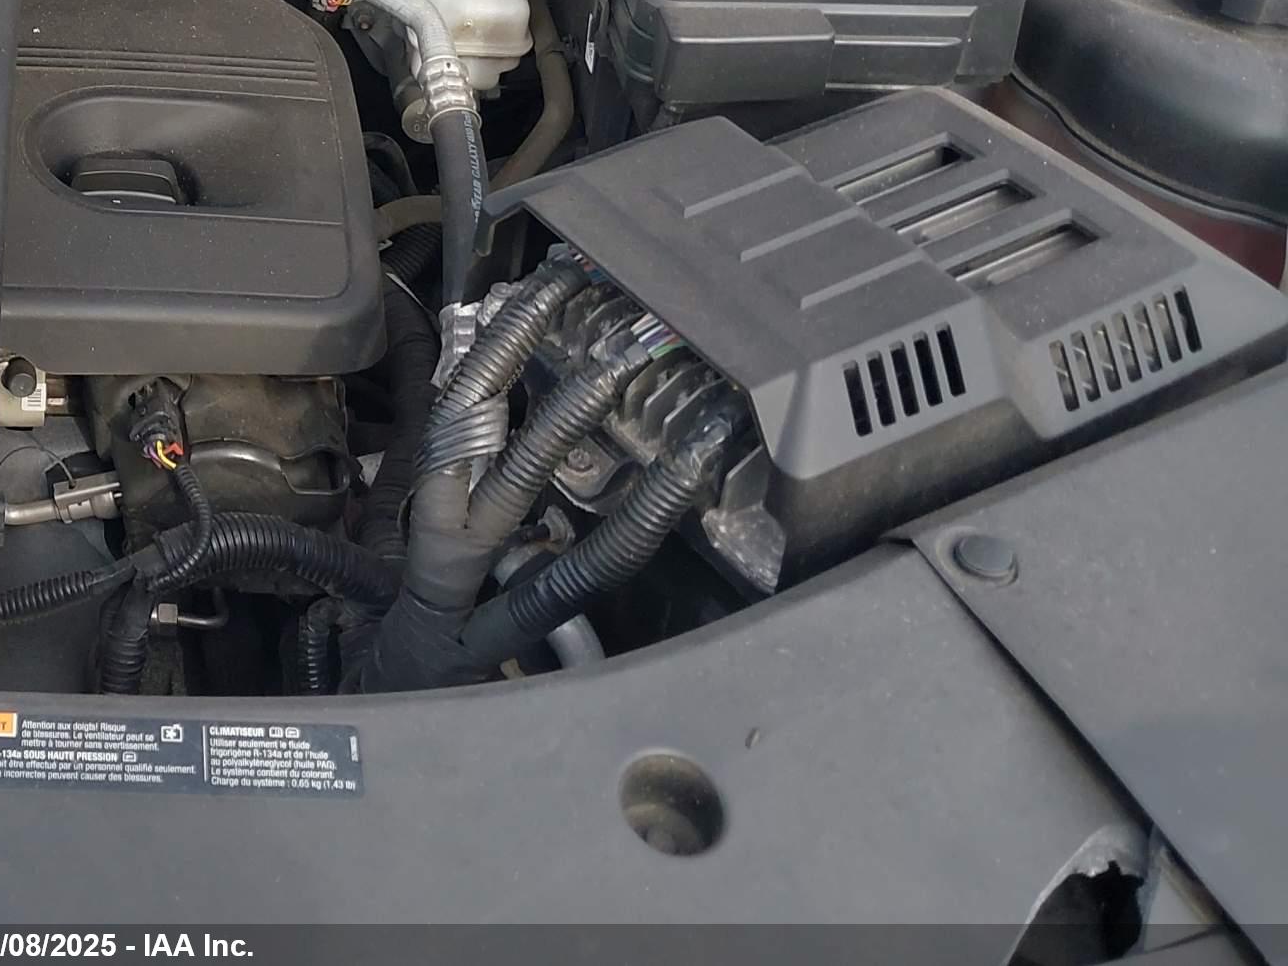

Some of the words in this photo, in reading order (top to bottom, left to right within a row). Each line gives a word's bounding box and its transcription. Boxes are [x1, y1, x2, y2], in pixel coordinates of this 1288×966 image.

[467, 143, 481, 179] GALAXY
[22, 720, 55, 730] Attention
[100, 723, 126, 733] Risque
[209, 726, 264, 737] CLIMATISEUR
[24, 749, 46, 759] SOUS
[48, 751, 74, 760] HAUTE
[77, 752, 117, 762] PRESSION
